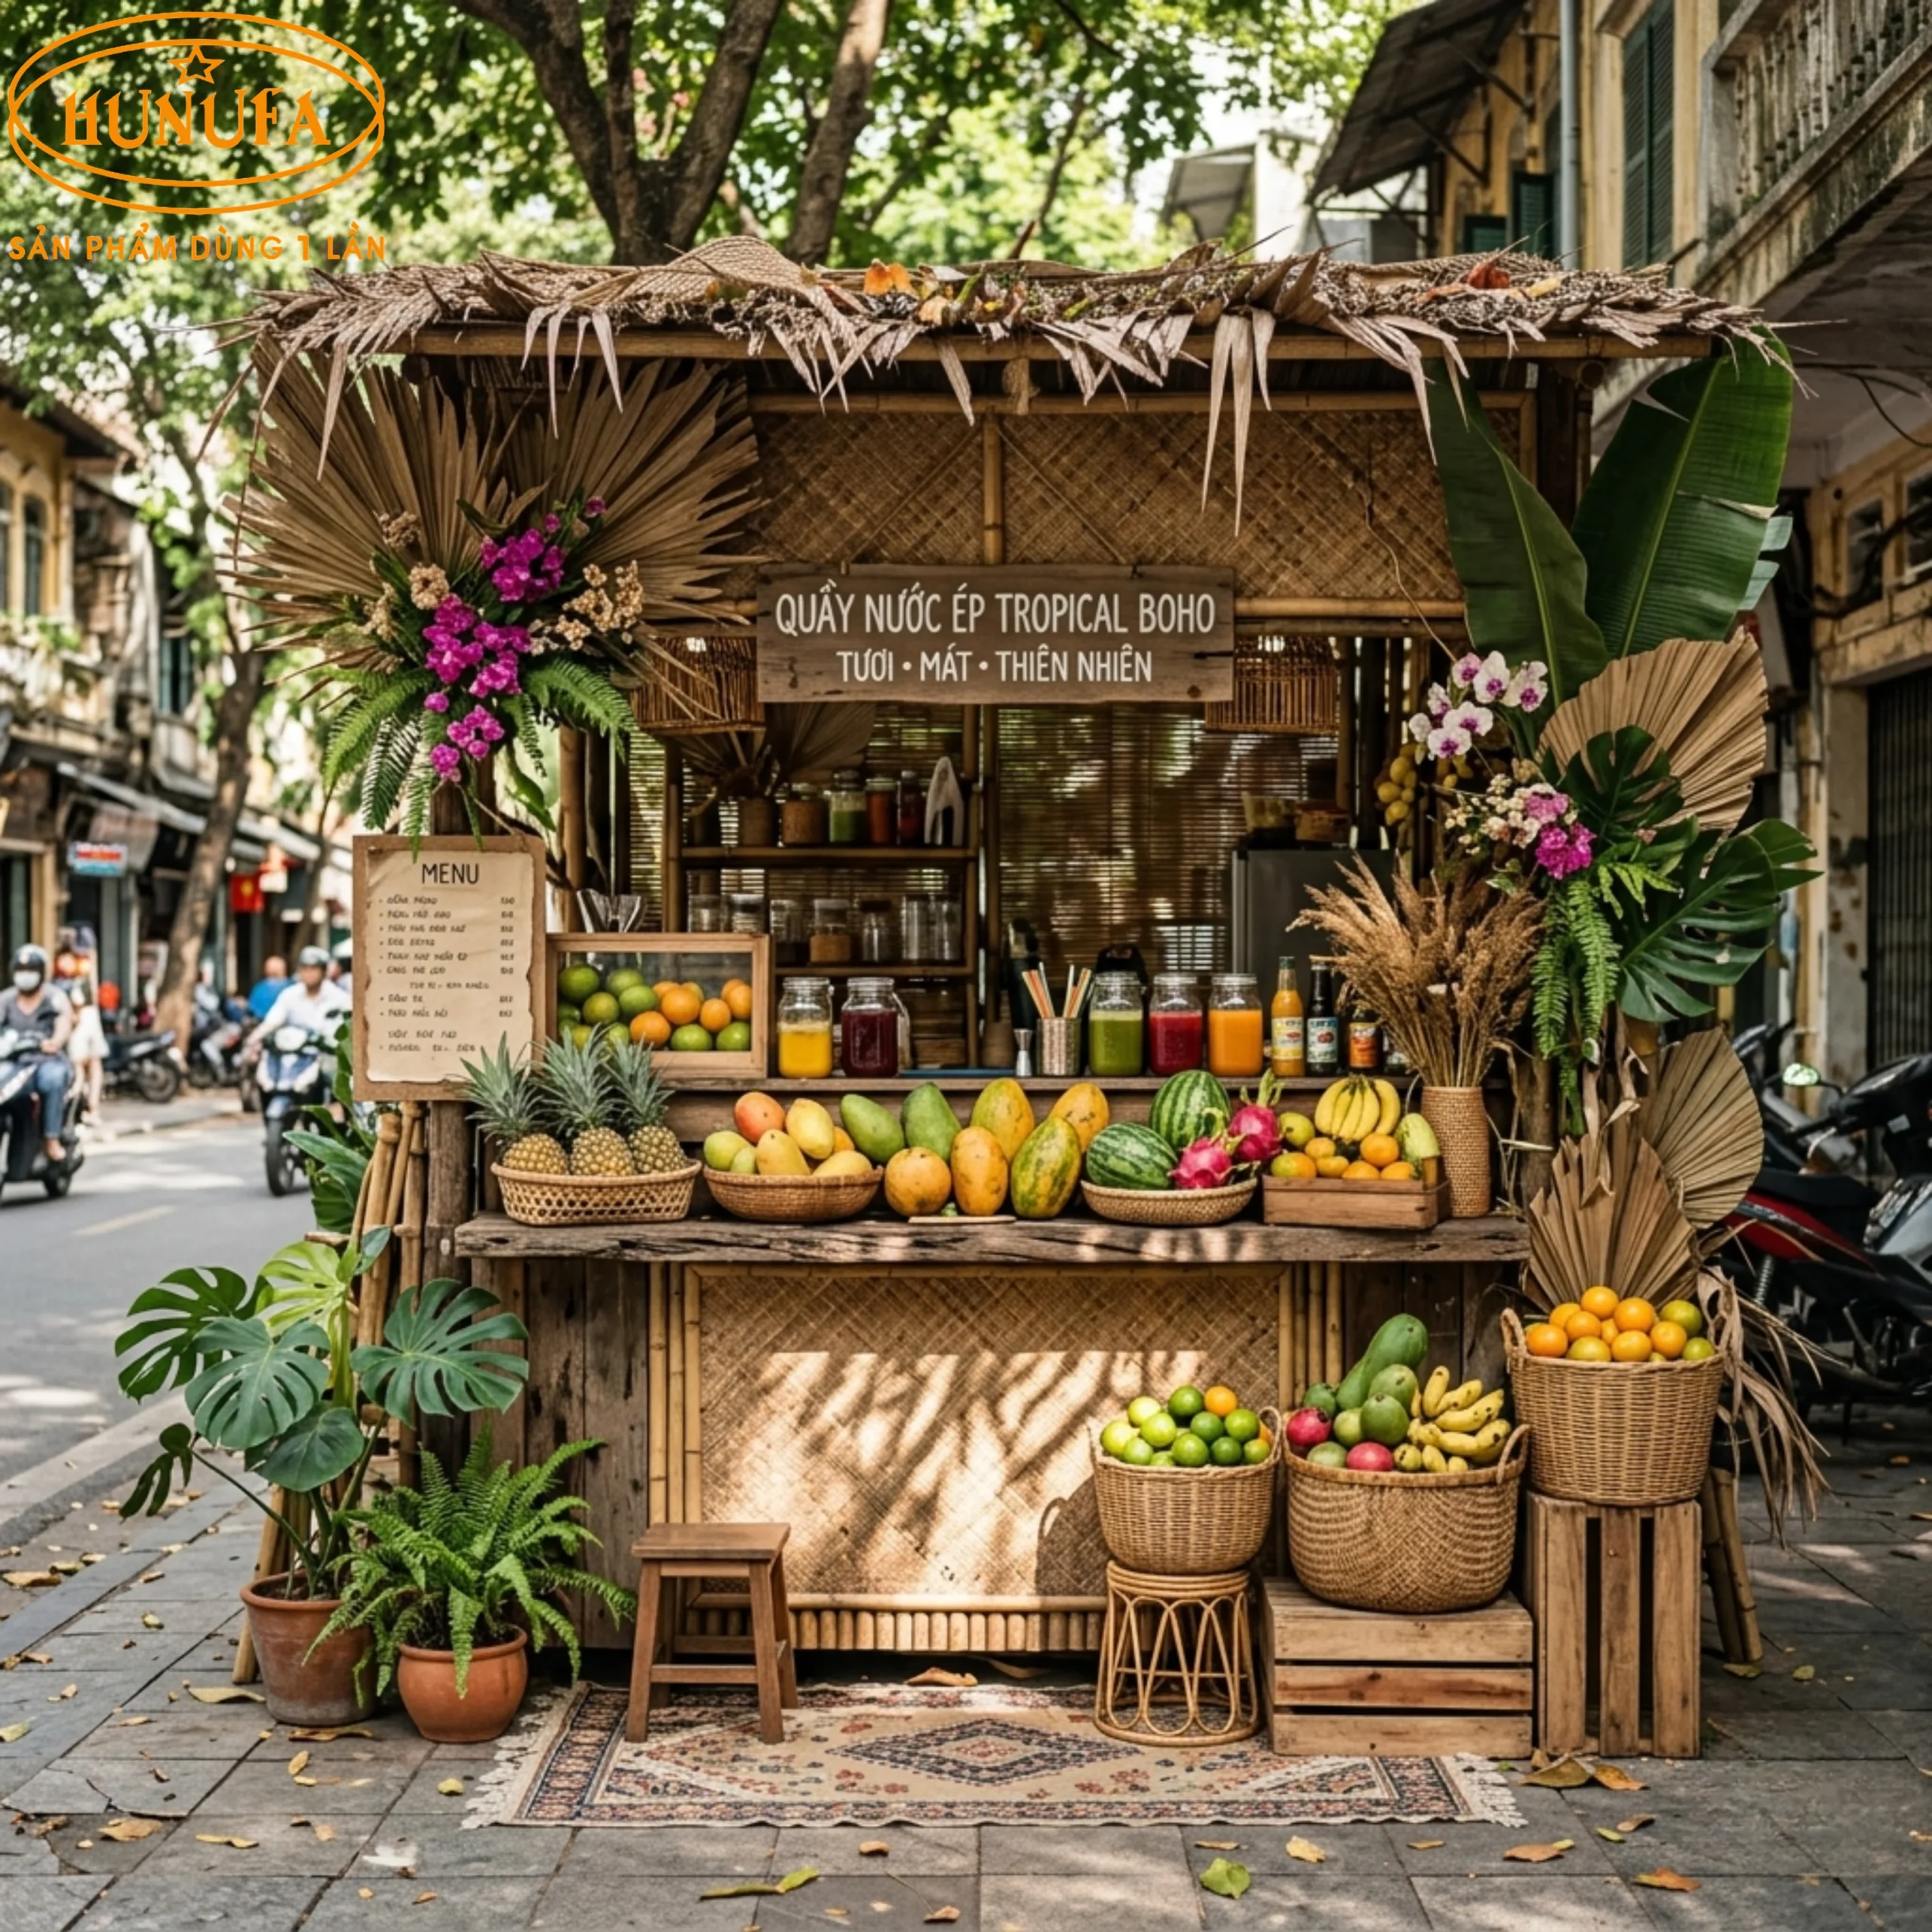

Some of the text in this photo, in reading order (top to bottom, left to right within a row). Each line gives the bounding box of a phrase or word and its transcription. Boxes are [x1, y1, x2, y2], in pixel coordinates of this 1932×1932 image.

[776, 578, 1216, 637] QUẦY NƯỚC ÉP TROPICAL BOHO
[835, 642, 1152, 683] TƯƠI MÁT THIÊN NHIÊN
[421, 863, 480, 885] MENU
